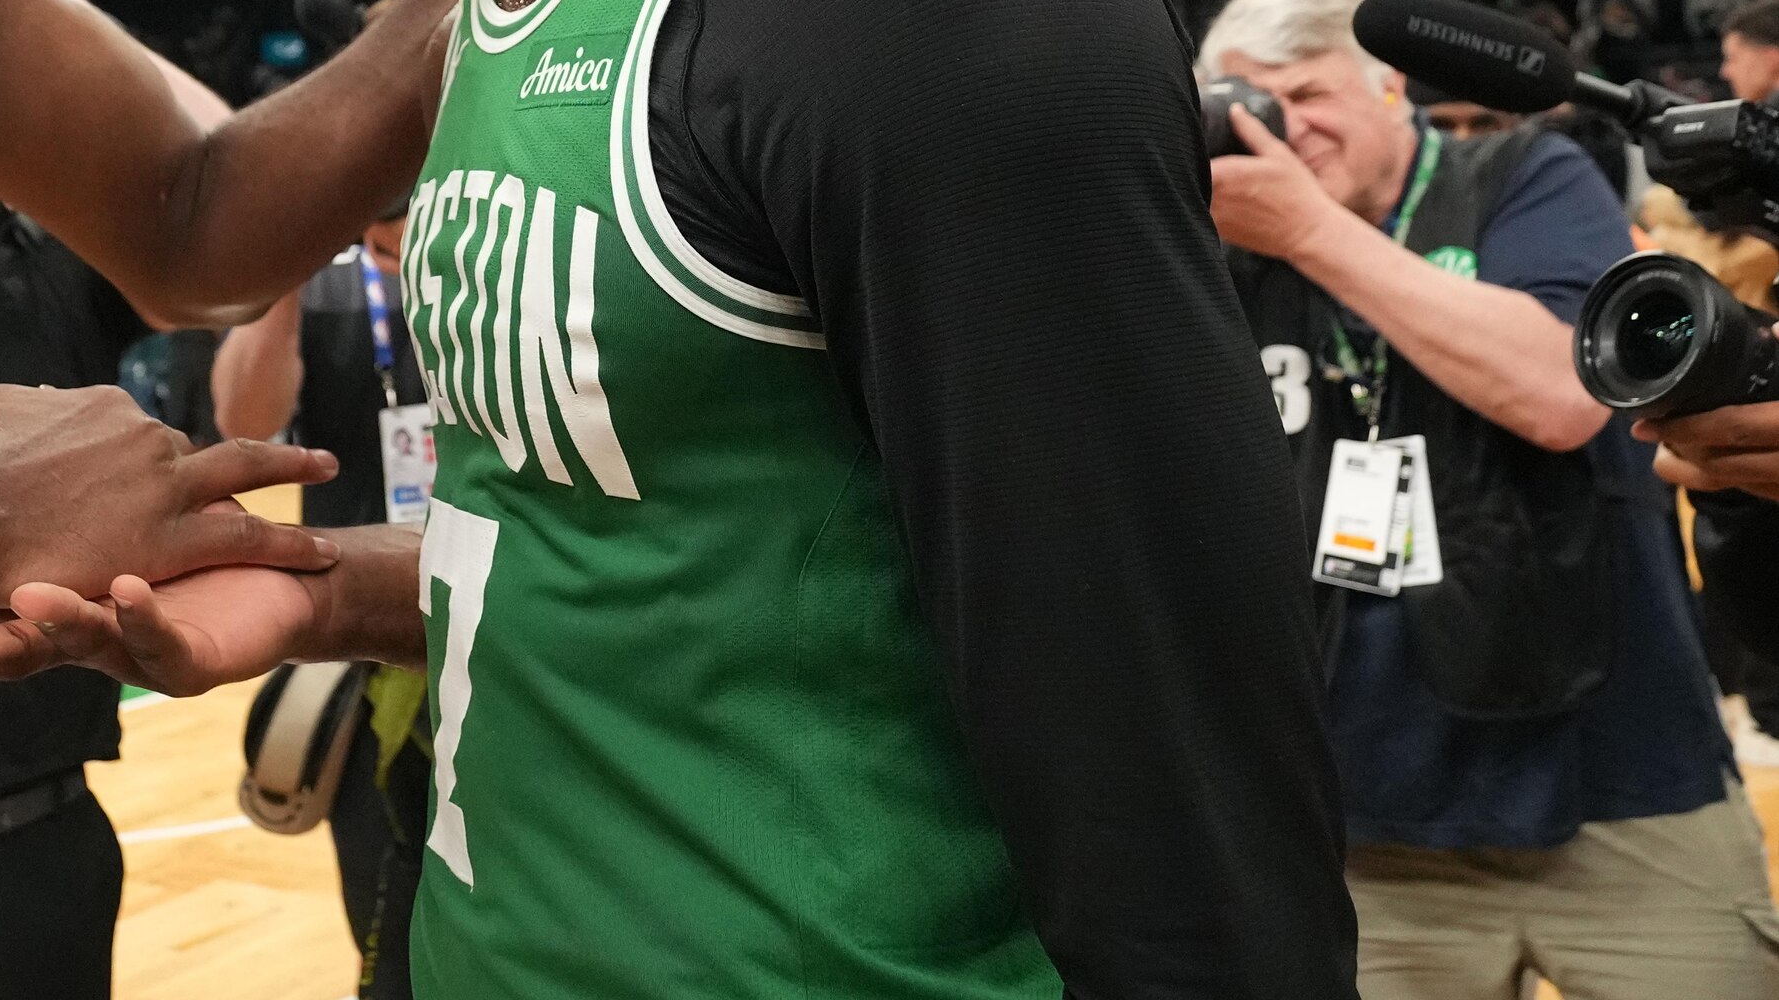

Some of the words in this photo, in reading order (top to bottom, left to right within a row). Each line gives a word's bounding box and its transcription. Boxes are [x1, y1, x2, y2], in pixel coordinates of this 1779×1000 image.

[520, 46, 614, 99] Amica
[1407, 14, 1515, 62] SENNHEISER
[400, 169, 642, 501] OSTON
[419, 497, 500, 892] 7
